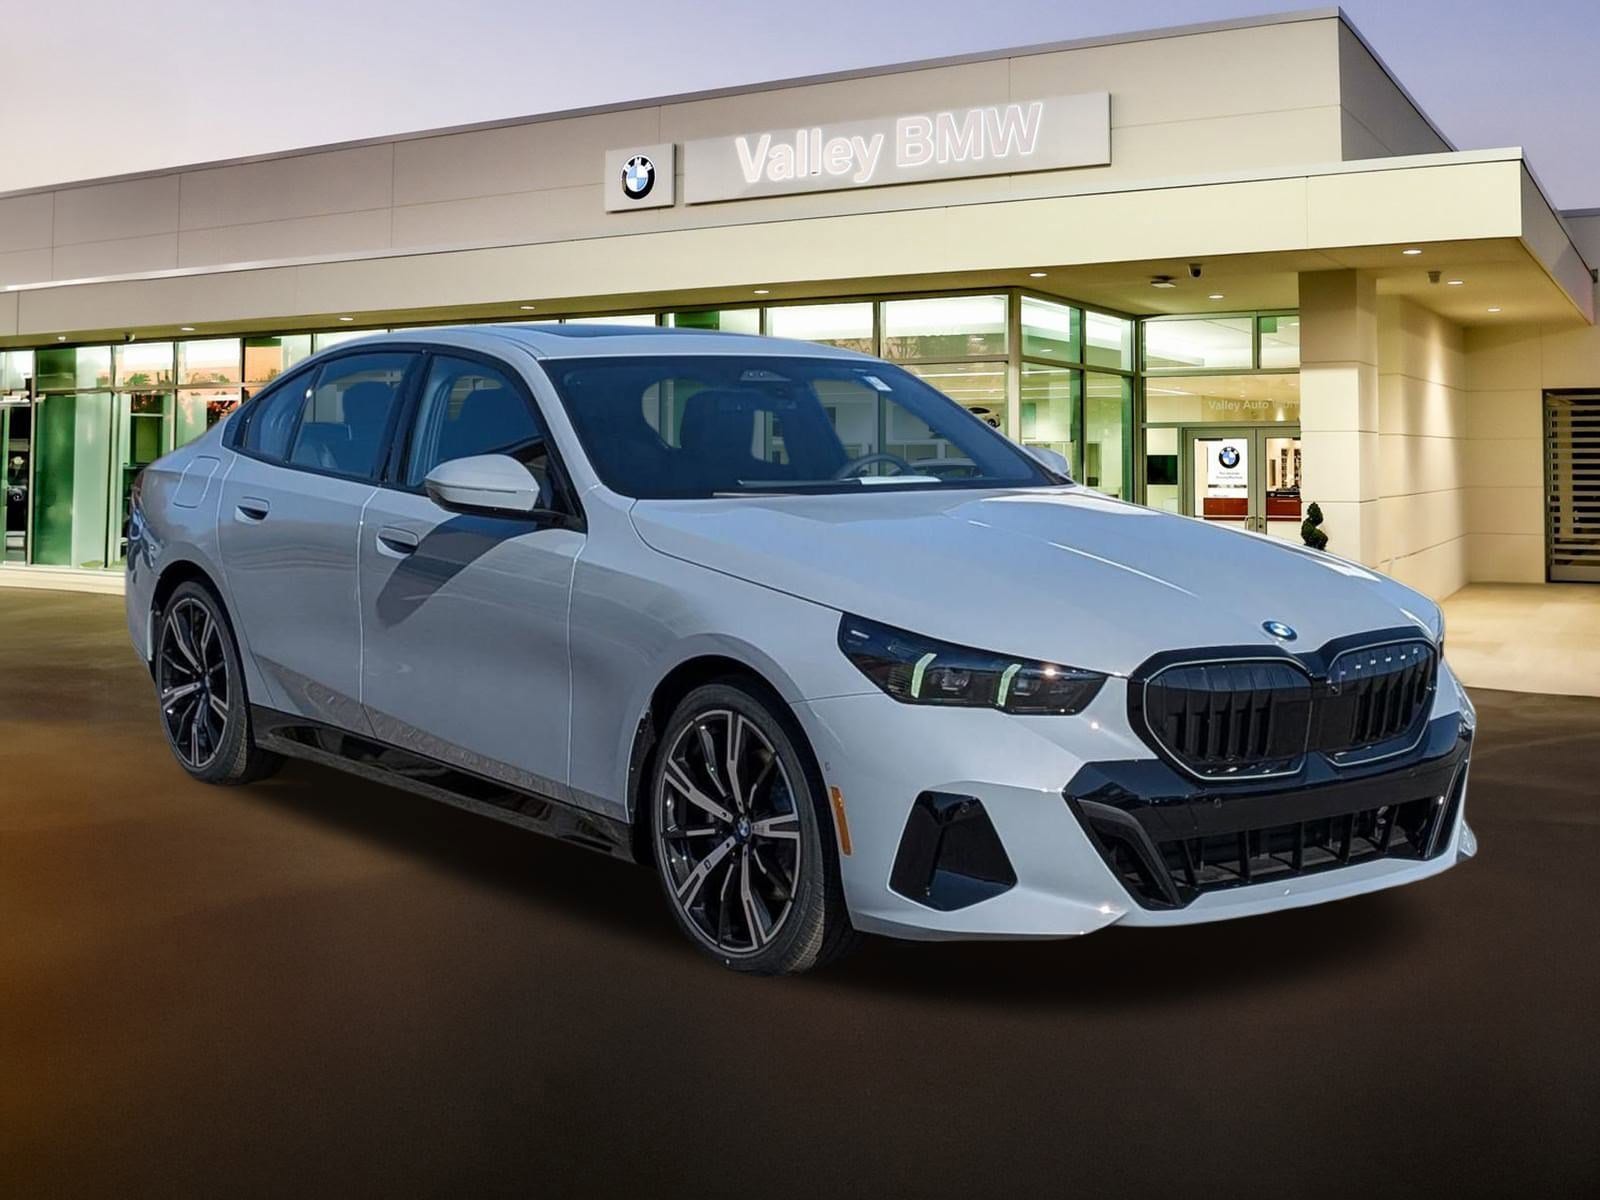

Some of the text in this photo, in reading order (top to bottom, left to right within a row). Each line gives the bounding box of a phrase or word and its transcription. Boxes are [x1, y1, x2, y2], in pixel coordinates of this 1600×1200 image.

[735, 101, 1043, 184] Valley BMW
[1208, 400, 1240, 412] Valley
[1243, 400, 1269, 409] Auto
